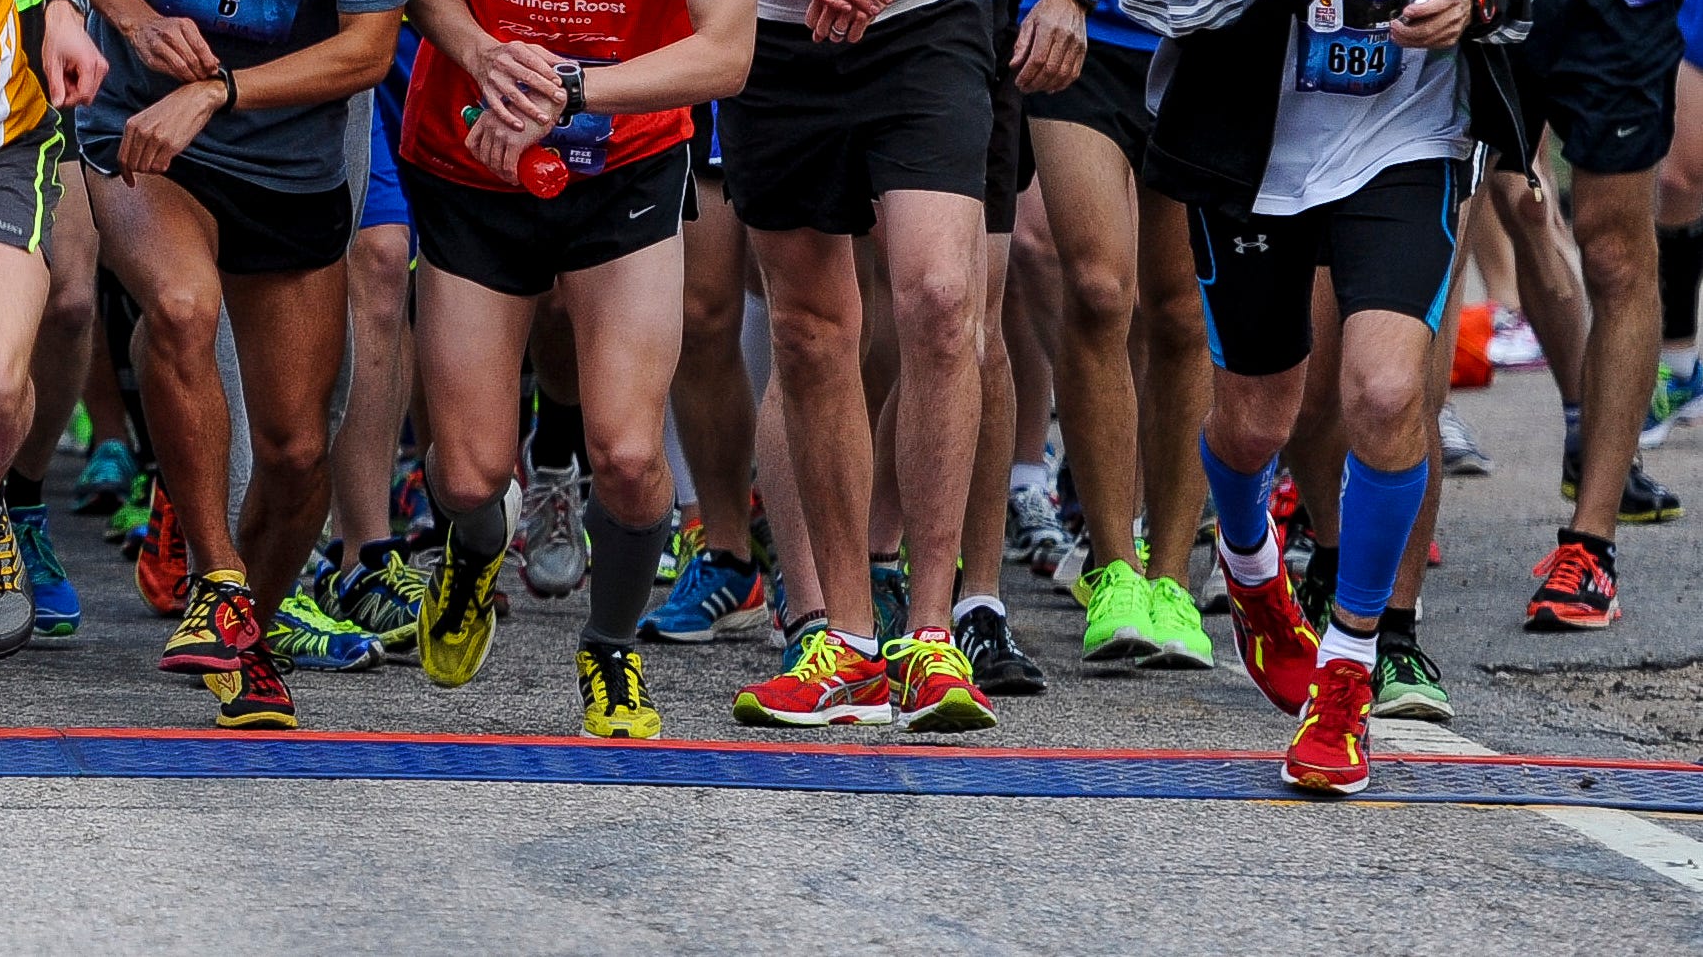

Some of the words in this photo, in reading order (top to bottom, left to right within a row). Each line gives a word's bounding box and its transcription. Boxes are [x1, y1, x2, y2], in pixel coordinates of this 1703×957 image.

[574, 0, 626, 14] Roost
[529, 13, 592, 24] COLORADO
[1328, 42, 1387, 77] 684
